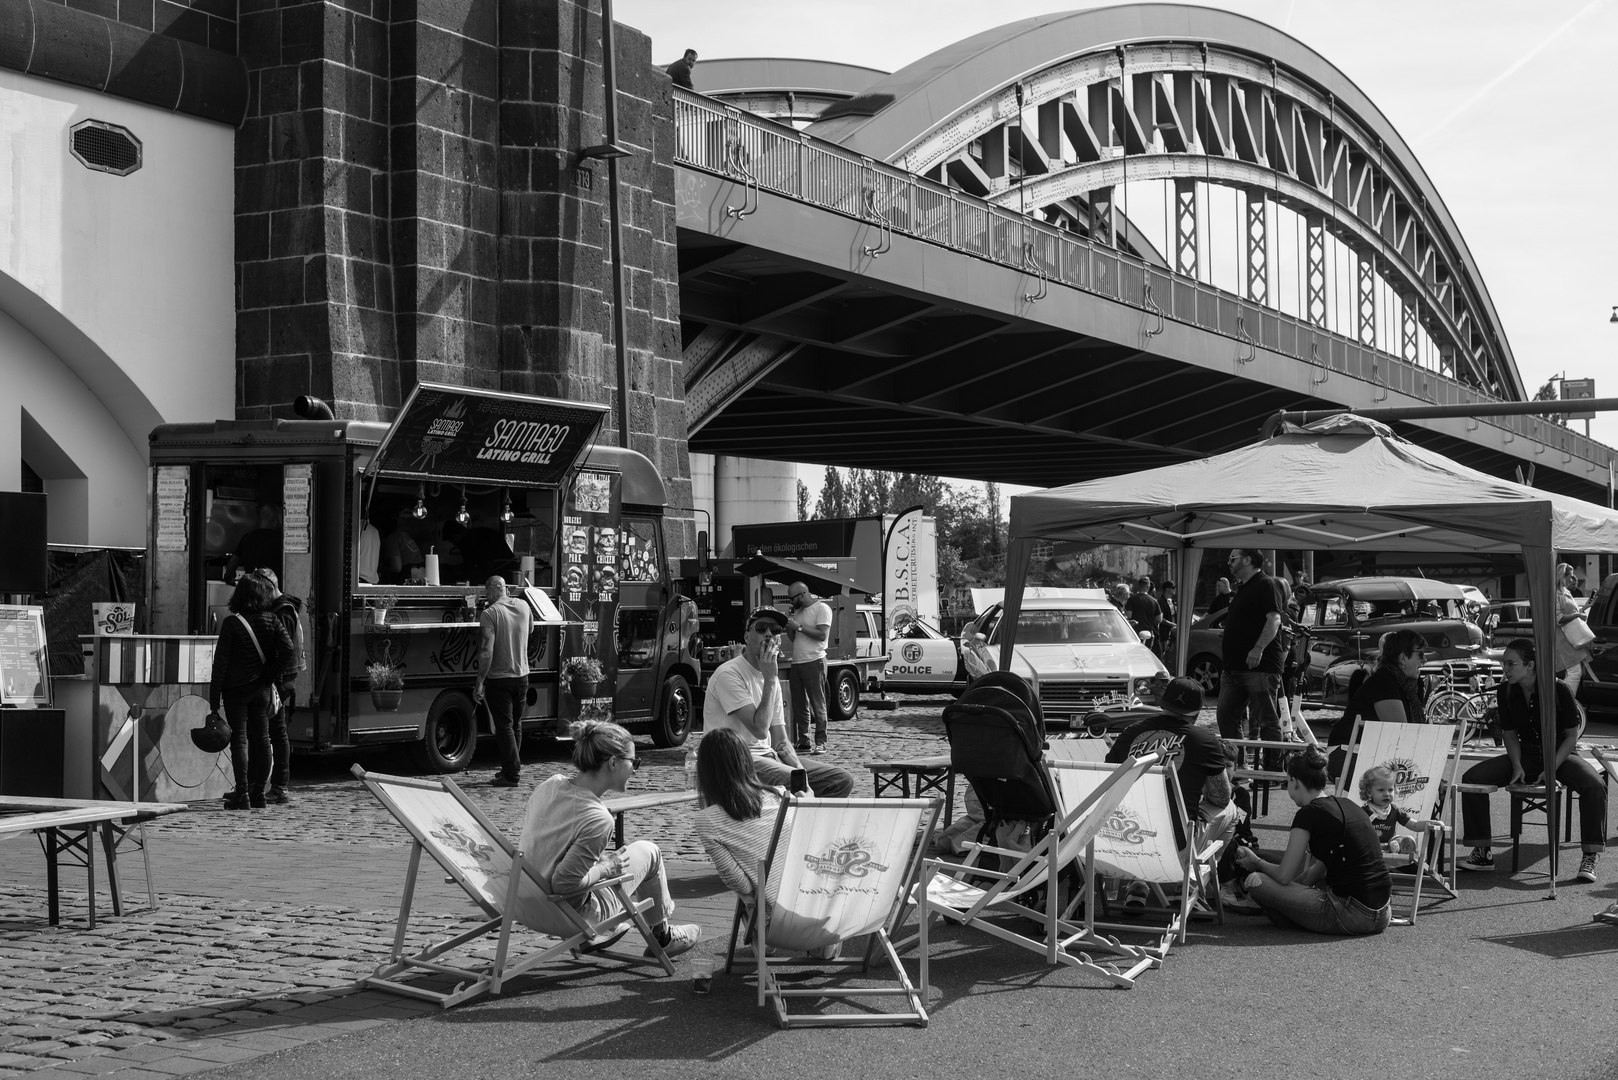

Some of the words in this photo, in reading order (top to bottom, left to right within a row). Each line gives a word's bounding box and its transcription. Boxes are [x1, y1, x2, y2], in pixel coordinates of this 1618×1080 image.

[430, 418, 464, 432] SANTIAGO
[485, 418, 570, 453] SANTIAGO
[476, 448, 521, 462] LATINO
[520, 451, 551, 465] GRILL
[747, 544, 758, 554] Für
[761, 543, 772, 553] den
[773, 541, 818, 553] ökologischen
[568, 553, 582, 563] PORK
[596, 555, 616, 564] CHICKEN
[894, 518, 911, 602] B.S.C.A.
[569, 592, 581, 602] BEEF
[892, 665, 932, 675] POLICE
[1130, 734, 1187, 757] FRANK
[1395, 770, 1417, 785] OL
